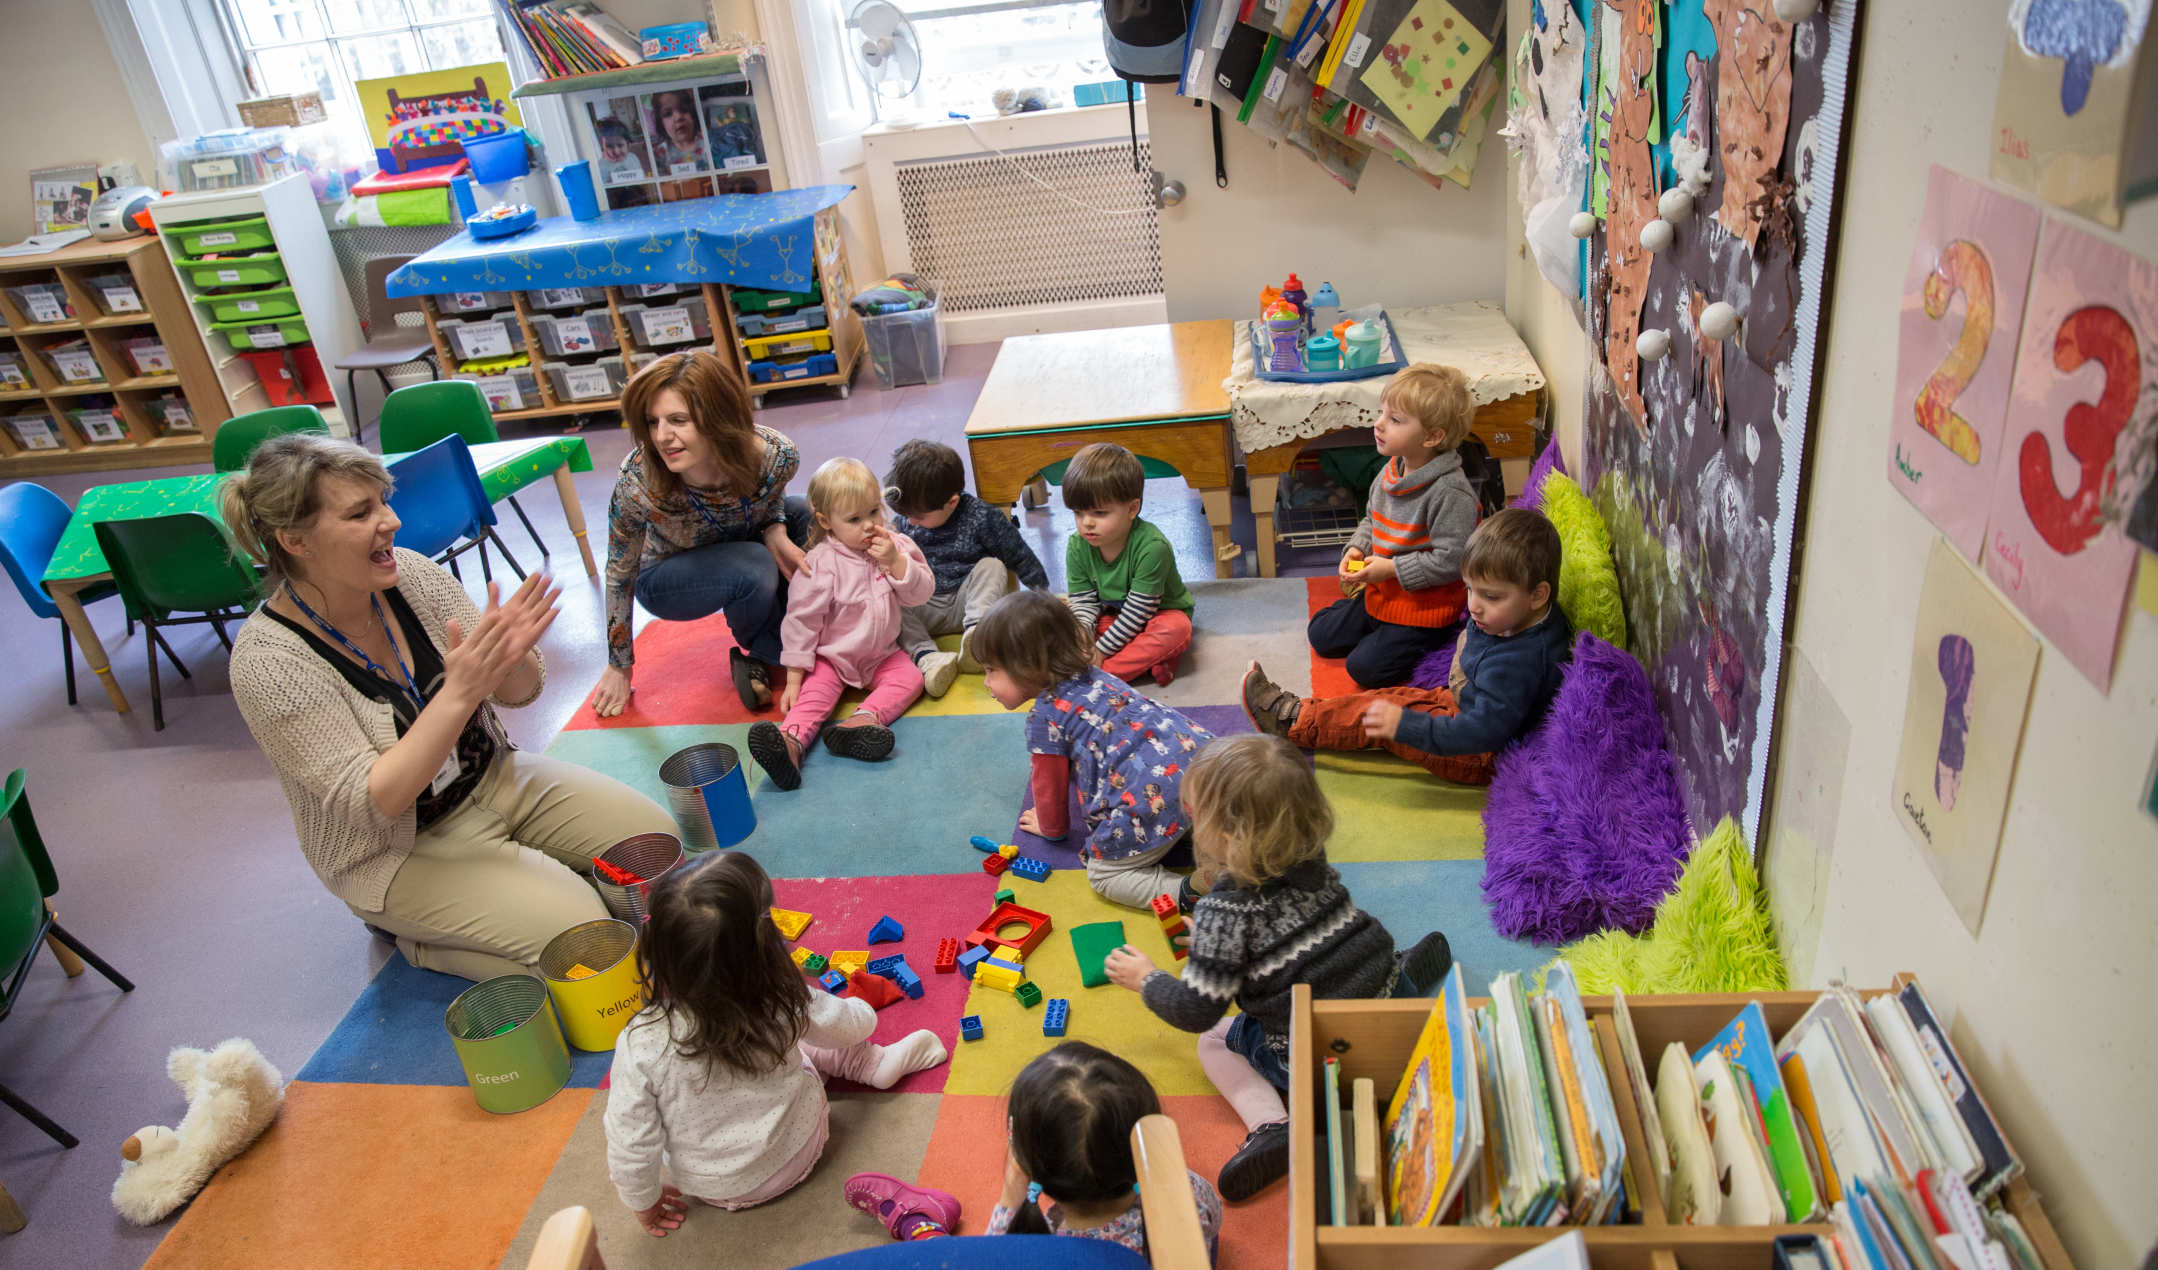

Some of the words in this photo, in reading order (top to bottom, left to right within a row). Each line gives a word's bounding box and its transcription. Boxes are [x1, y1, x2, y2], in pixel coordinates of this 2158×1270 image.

[1348, 44, 1363, 63] Ellie
[731, 157, 750, 166] Tired
[566, 323, 581, 332] Cars
[1915, 238, 1995, 467] 2
[2019, 304, 2141, 557] 3
[596, 989, 640, 1019] Yellow
[475, 1070, 520, 1085] Green
